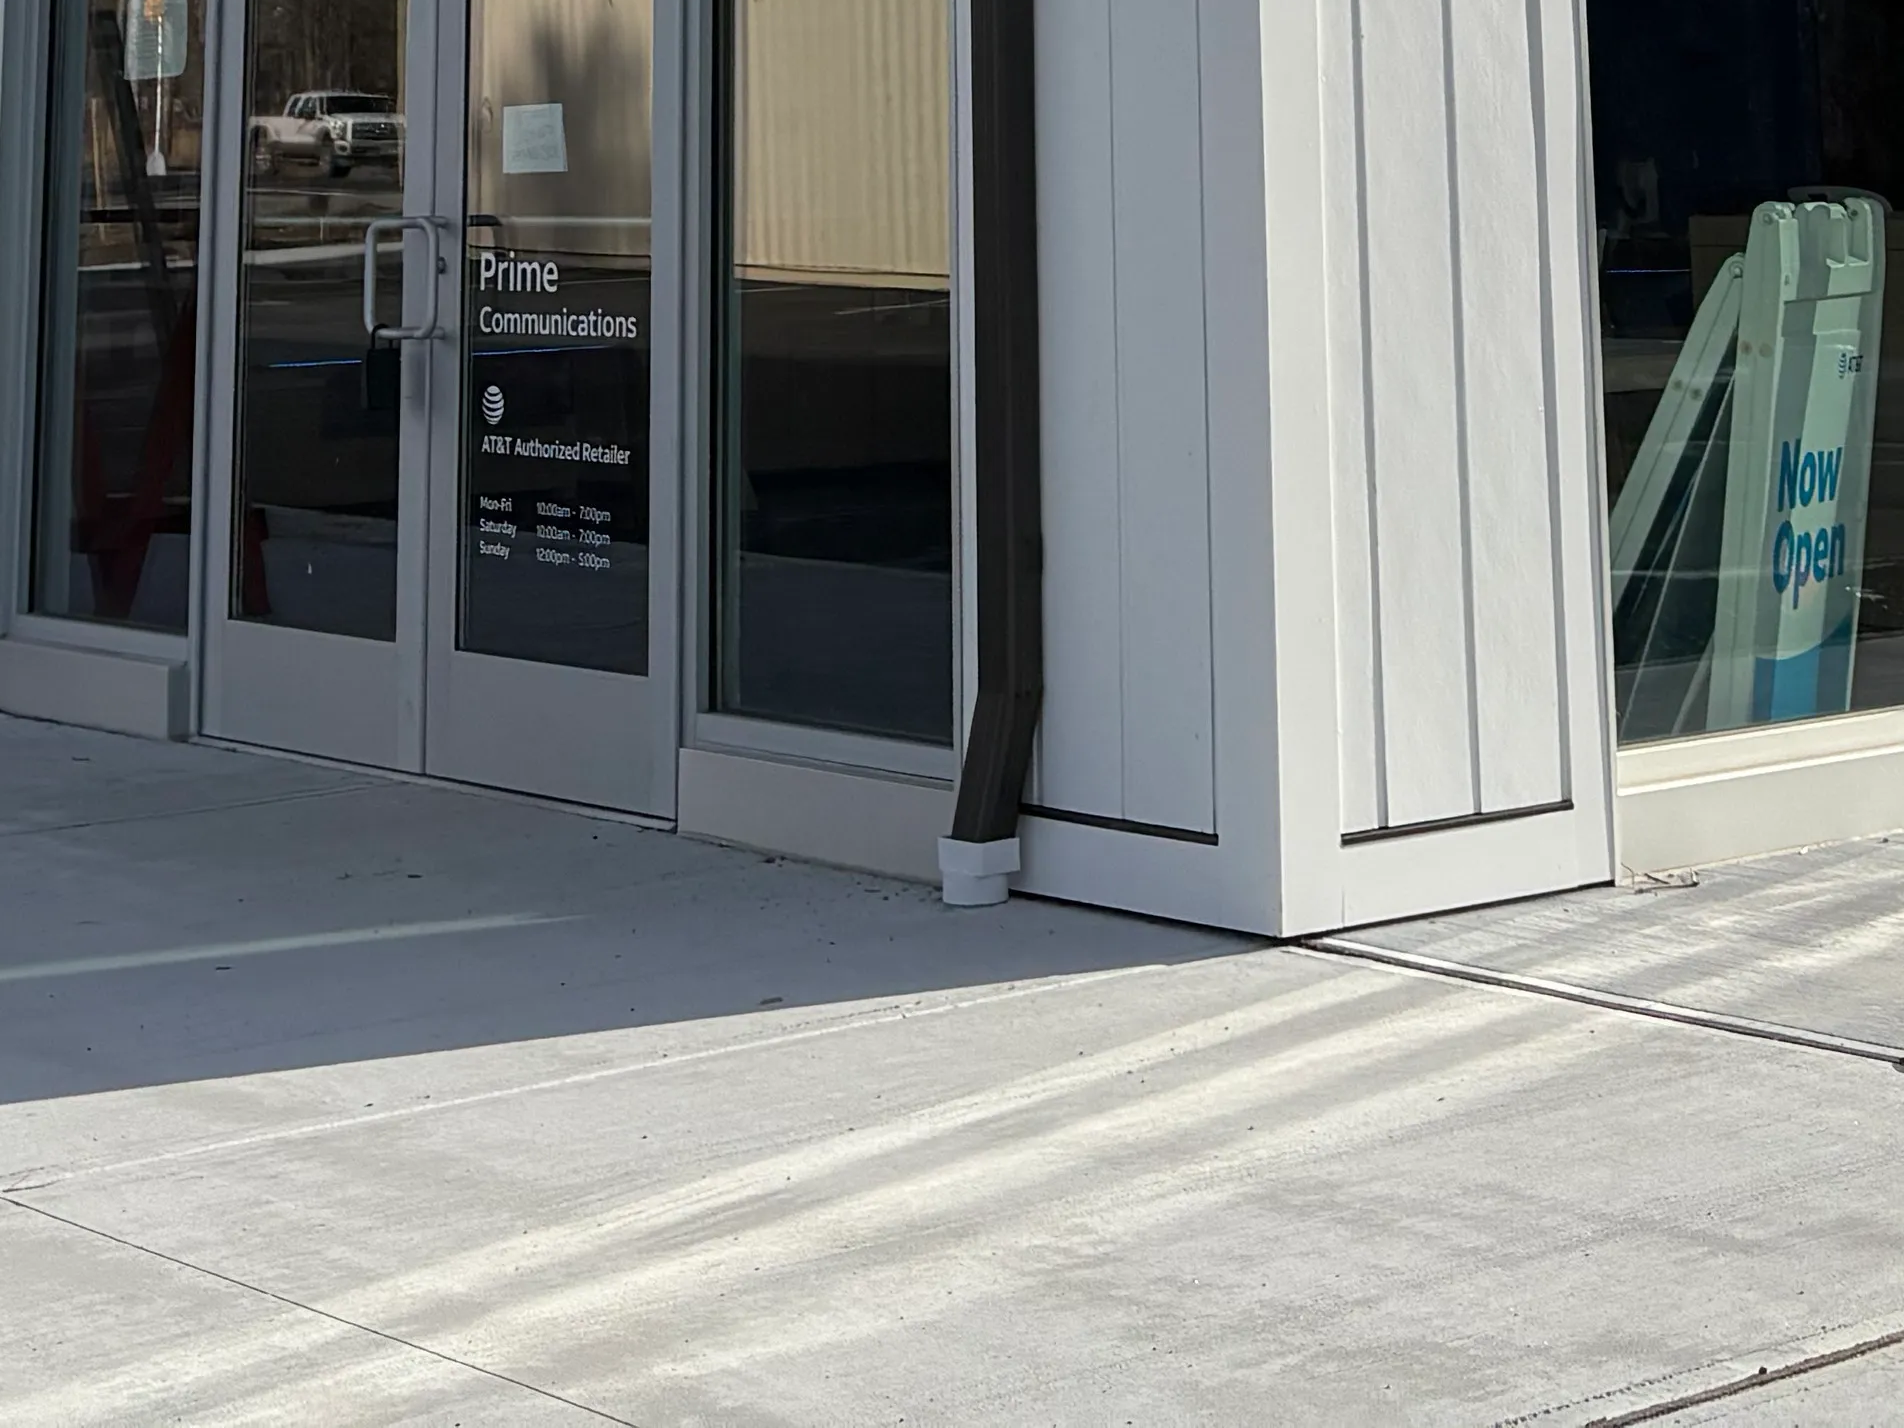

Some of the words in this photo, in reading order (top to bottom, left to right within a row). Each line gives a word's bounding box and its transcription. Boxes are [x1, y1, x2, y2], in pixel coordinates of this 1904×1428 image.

[479, 250, 559, 293] Prime
[479, 305, 637, 339] Communications
[481, 435, 512, 455] AT&T
[514, 438, 581, 461] Authorized
[582, 442, 631, 465] Retailer
[1777, 438, 1843, 513] Now
[479, 496, 513, 512] Mon-Fri
[479, 518, 517, 539] Saturday
[479, 541, 511, 561] Sunday
[1772, 519, 1846, 611] Open
